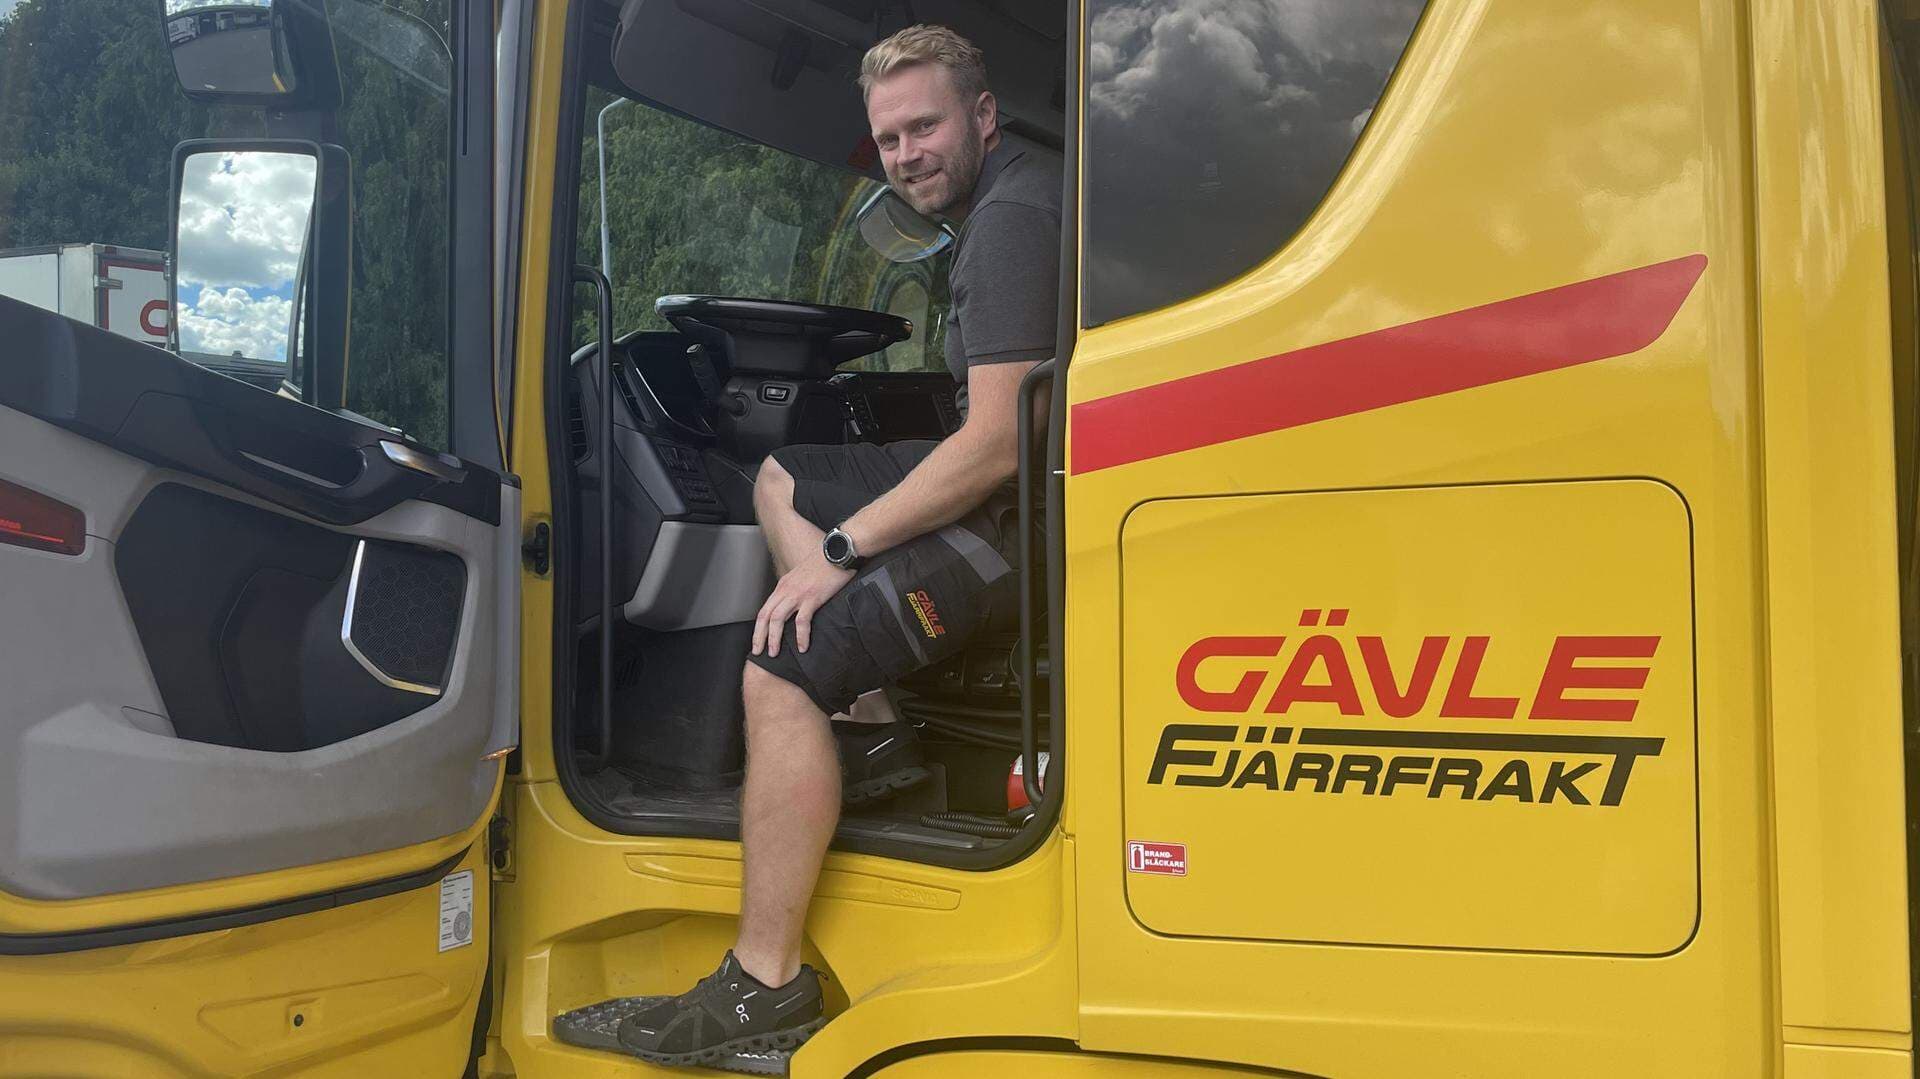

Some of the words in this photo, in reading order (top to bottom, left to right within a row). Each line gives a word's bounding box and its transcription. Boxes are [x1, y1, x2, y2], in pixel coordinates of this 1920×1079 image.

[916, 590, 946, 635] GÄVLE
[1175, 608, 1662, 722] GÄVLE
[1147, 723, 1666, 807] FJÄRRFRAKT
[1144, 858, 1185, 868] SLÄCKARE
